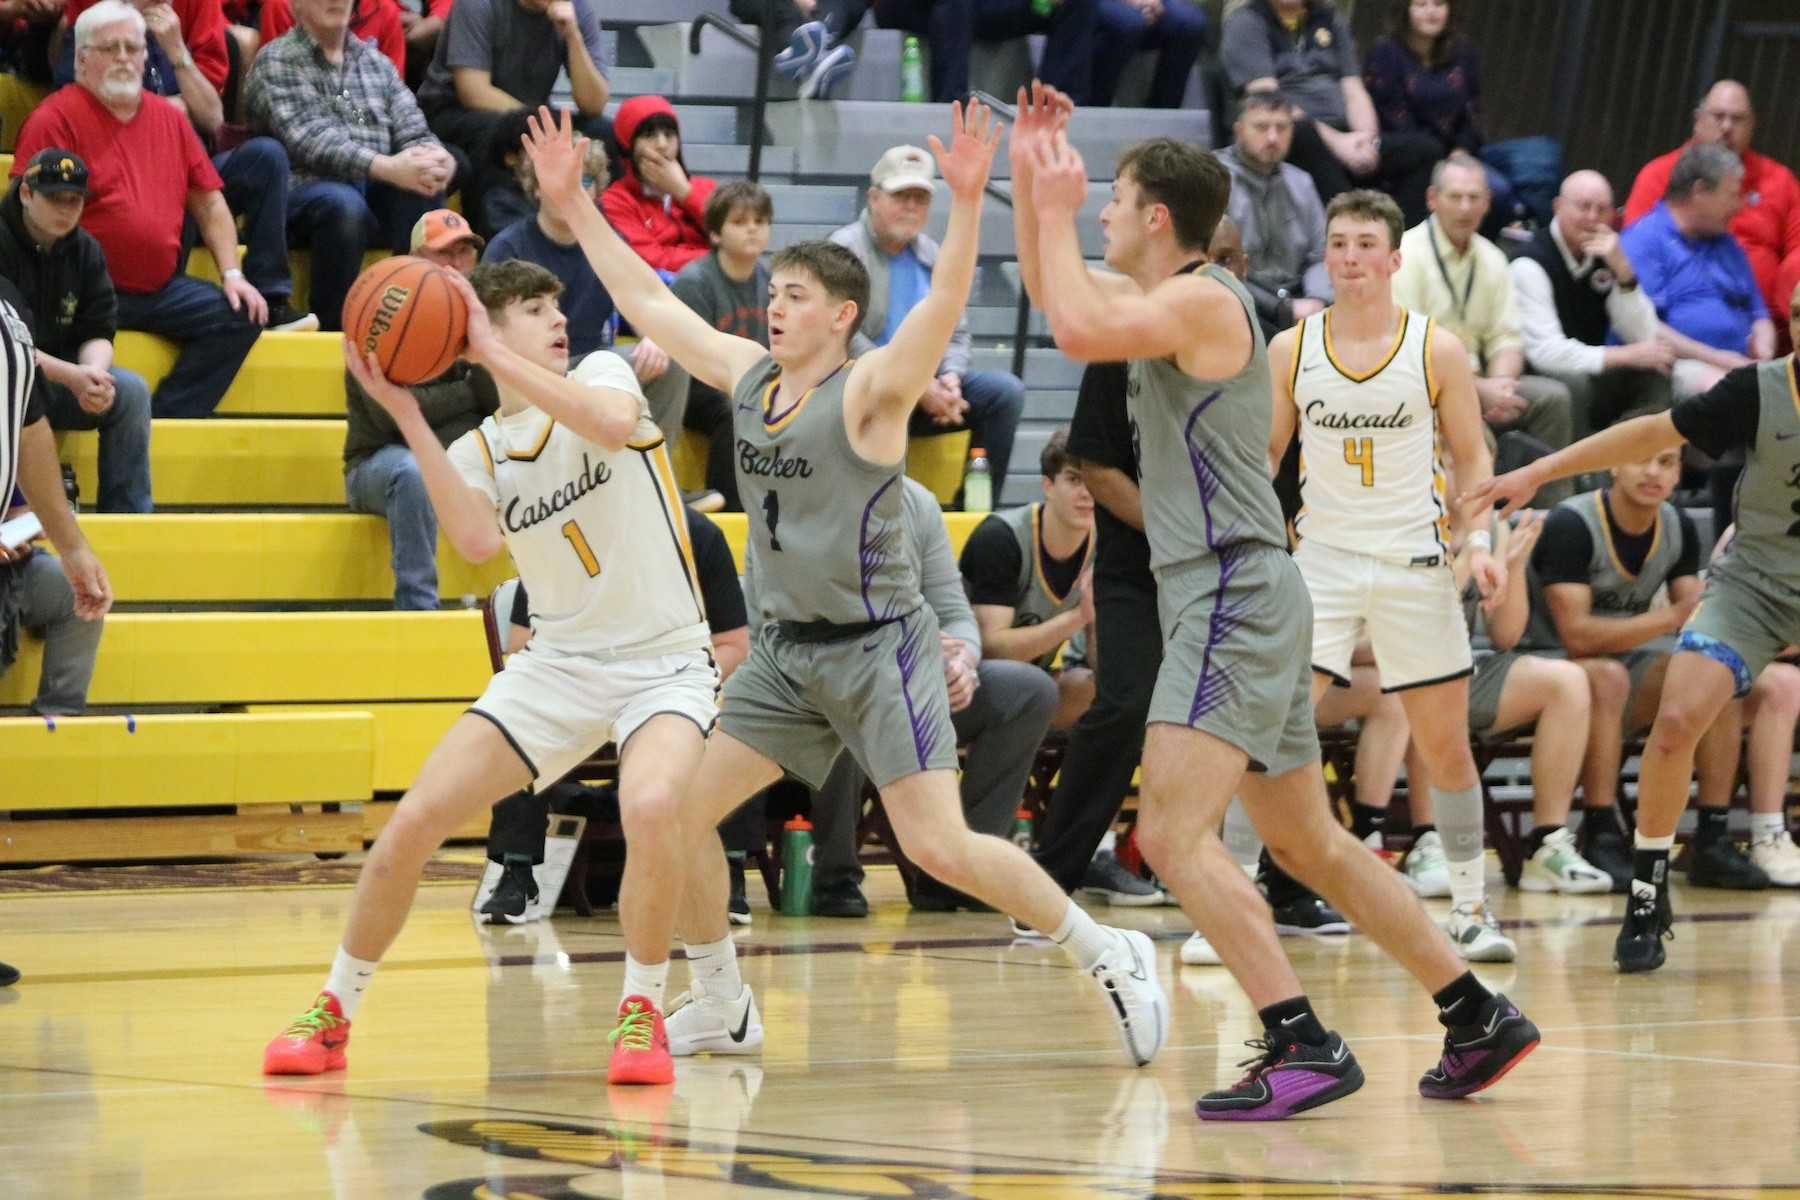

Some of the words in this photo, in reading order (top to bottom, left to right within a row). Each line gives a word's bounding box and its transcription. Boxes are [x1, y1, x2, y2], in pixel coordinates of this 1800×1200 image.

[362, 286, 408, 361] Wilso
[1305, 399, 1413, 429] Cascade
[737, 439, 813, 478] Baker
[1343, 437, 1374, 487] 4
[505, 452, 612, 533] Cascade
[763, 489, 783, 552] 1
[561, 518, 601, 578] 1
